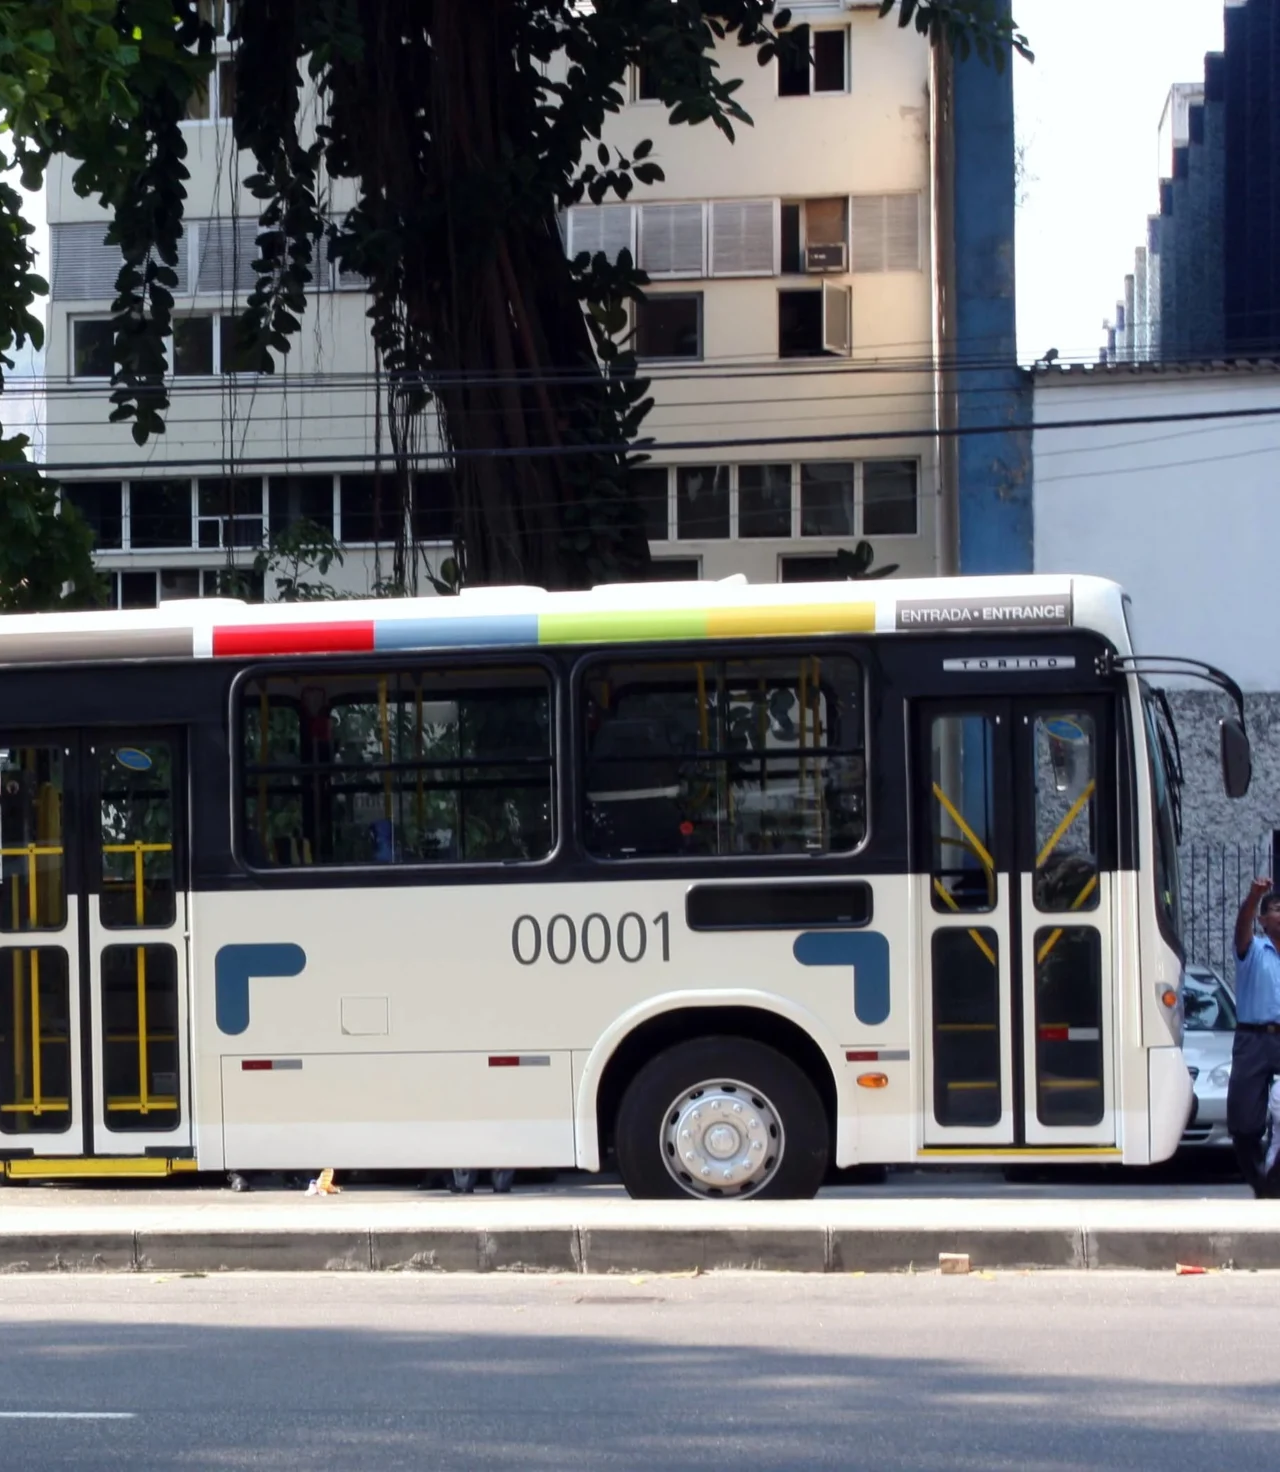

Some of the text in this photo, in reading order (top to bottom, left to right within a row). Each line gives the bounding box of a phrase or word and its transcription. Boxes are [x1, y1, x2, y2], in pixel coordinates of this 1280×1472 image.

[901, 605, 1065, 623] ENTRADA ENTRANCE
[511, 911, 670, 966] 00001
